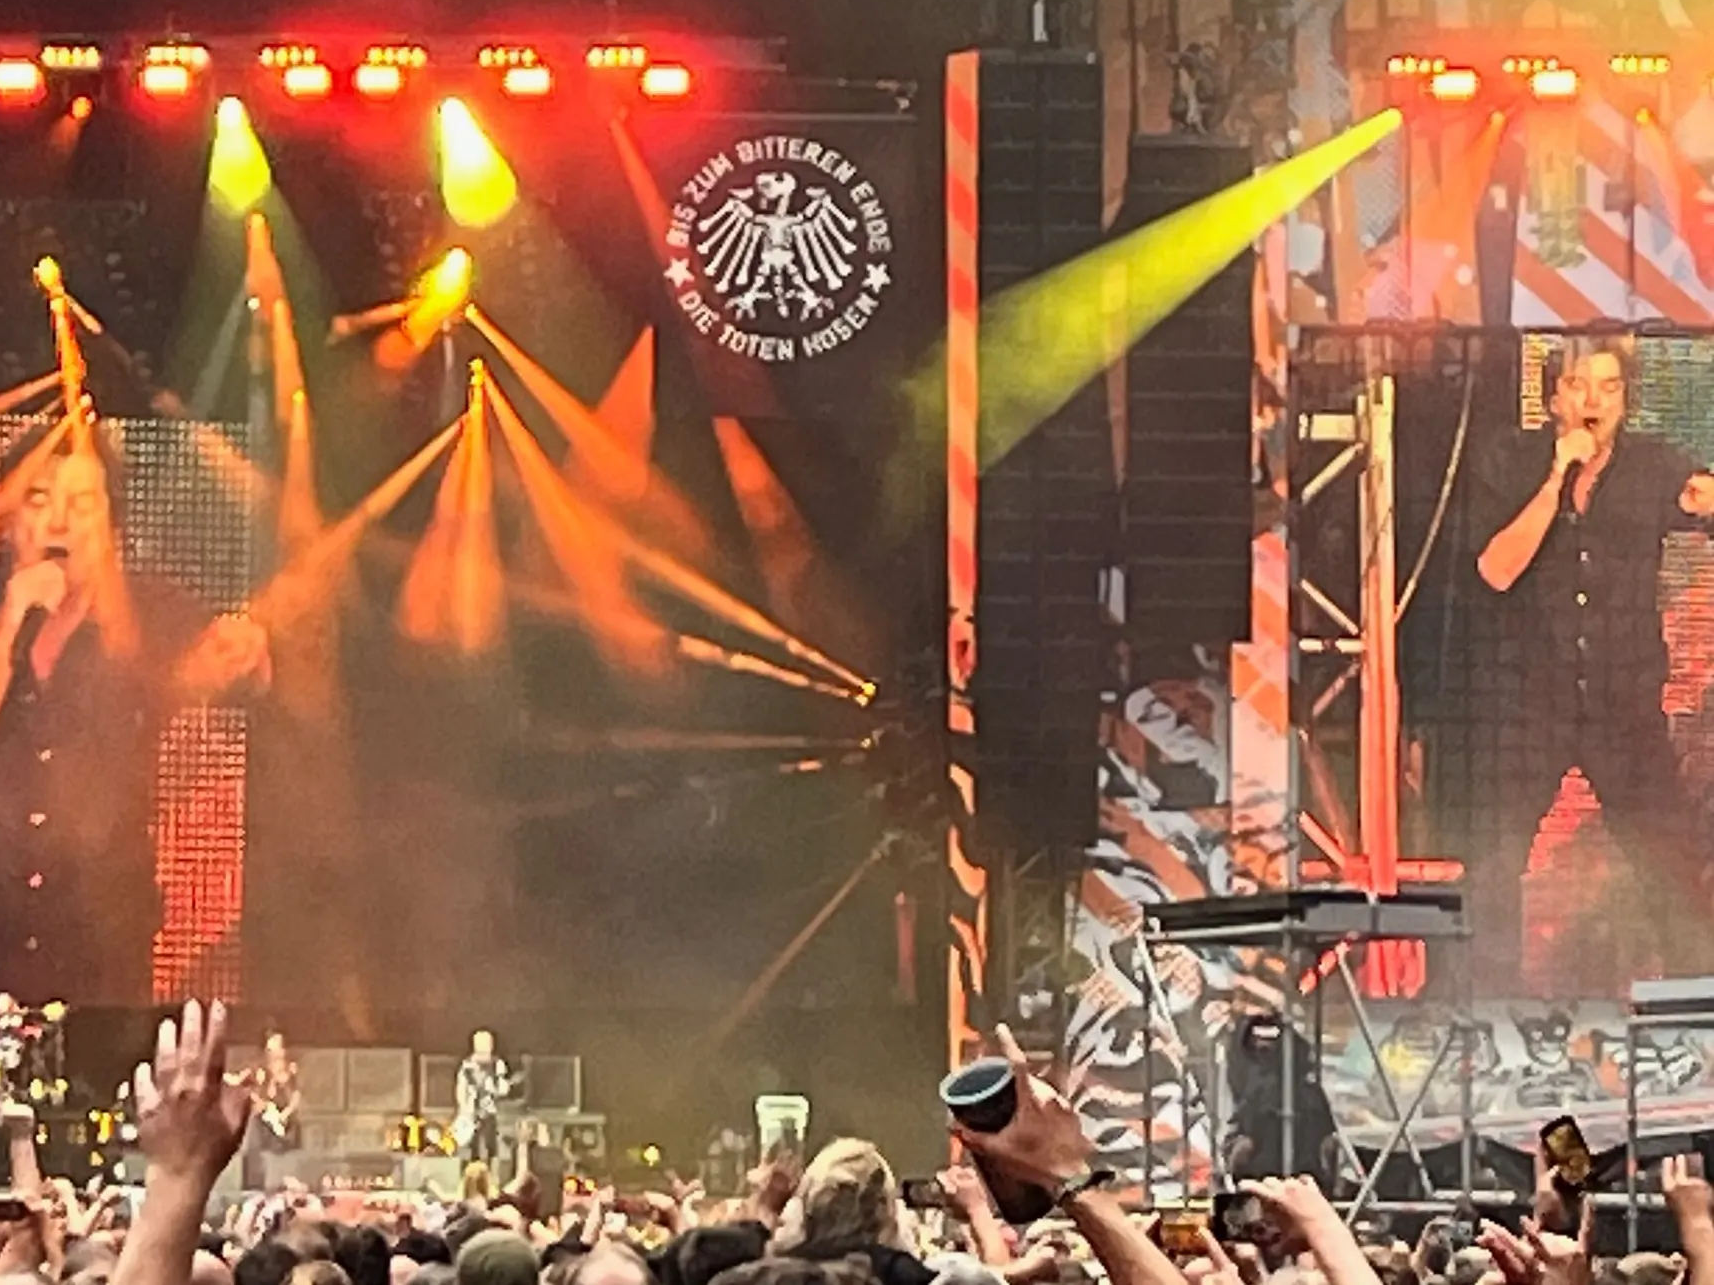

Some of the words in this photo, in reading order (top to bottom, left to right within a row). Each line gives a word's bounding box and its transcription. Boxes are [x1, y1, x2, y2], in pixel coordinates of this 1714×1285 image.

[665, 202, 698, 249] BIS
[682, 151, 734, 204] ZUM
[735, 135, 857, 185] BITTEREN
[849, 180, 893, 254] ENDE
[677, 289, 721, 336] DIE
[717, 322, 796, 361] TOTEN
[802, 291, 880, 358] HOSEN
